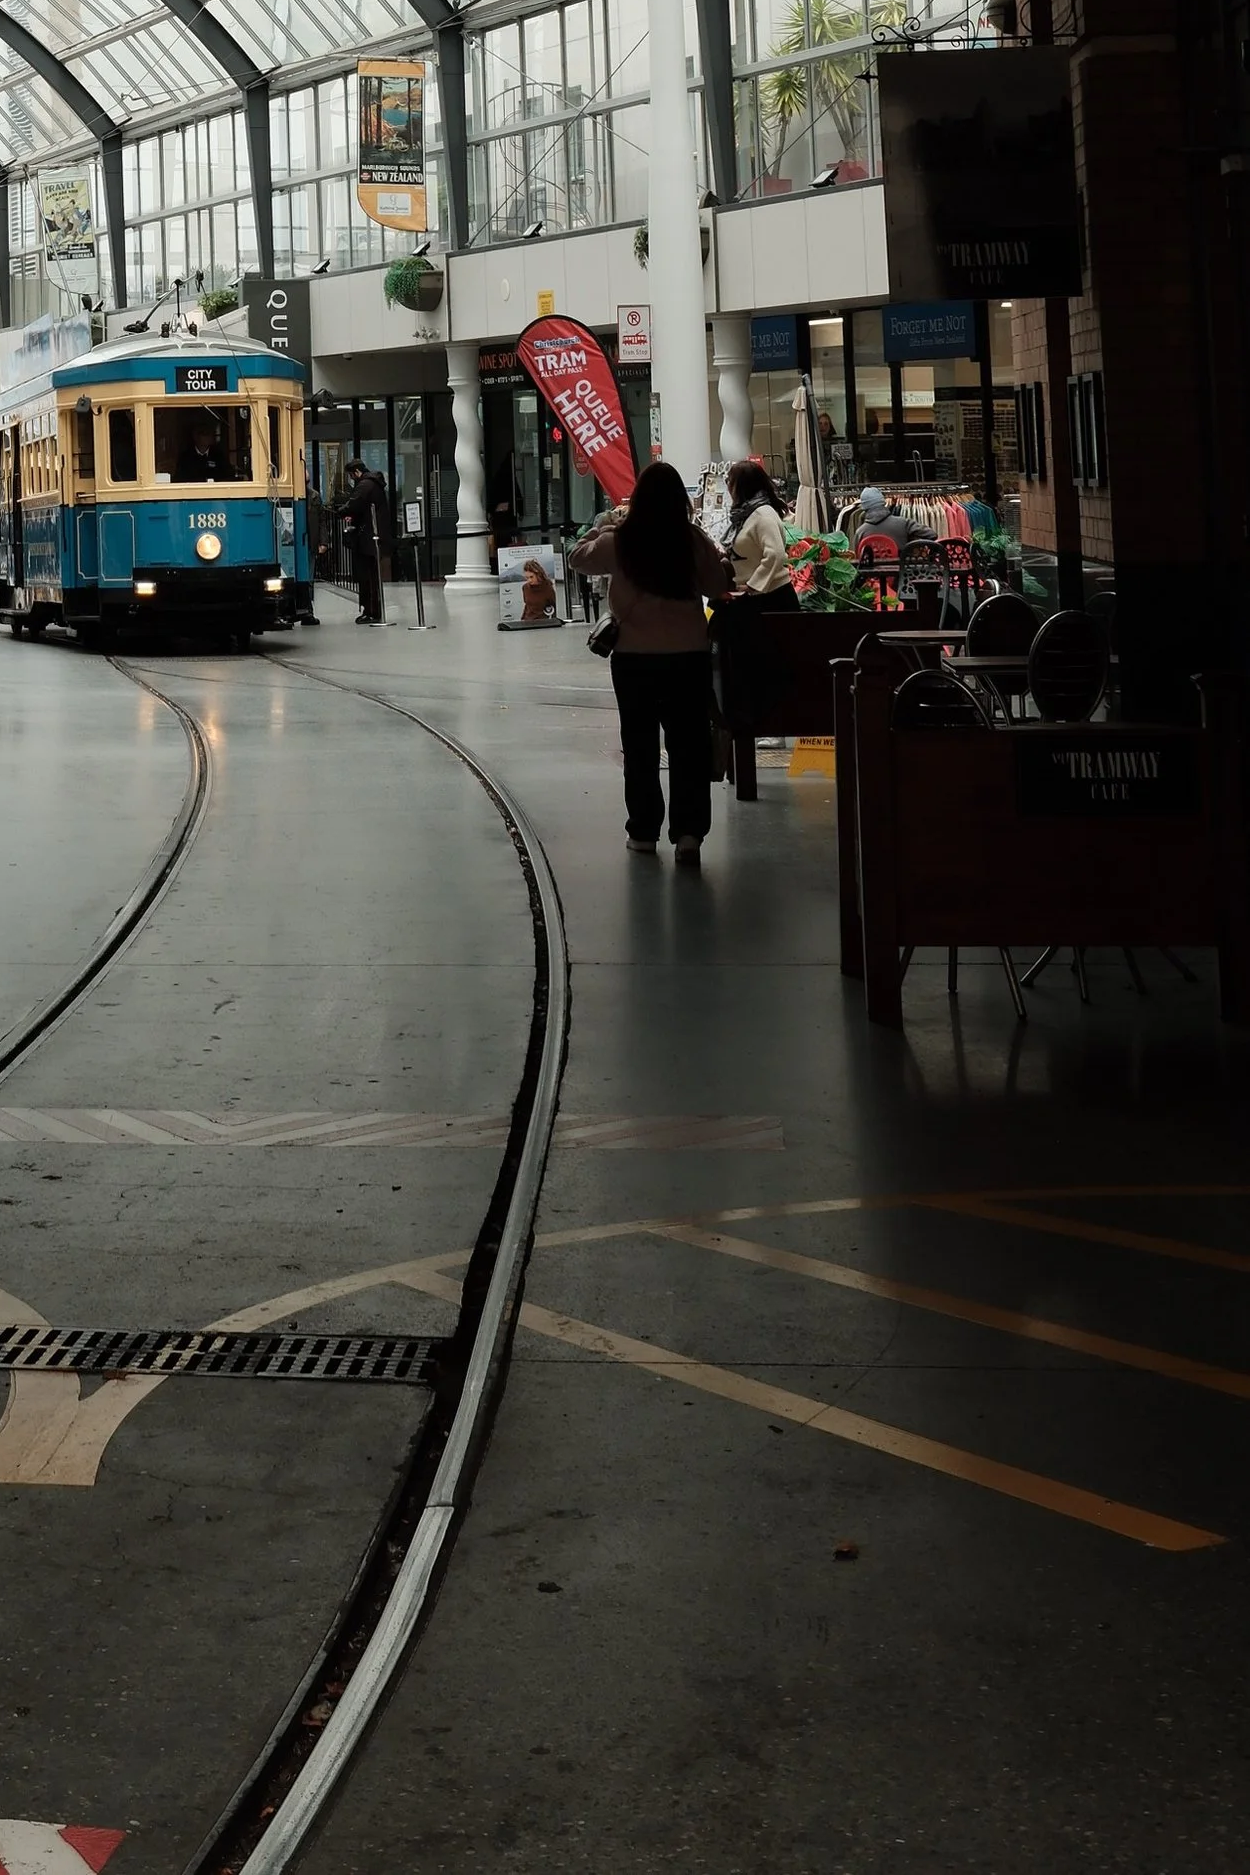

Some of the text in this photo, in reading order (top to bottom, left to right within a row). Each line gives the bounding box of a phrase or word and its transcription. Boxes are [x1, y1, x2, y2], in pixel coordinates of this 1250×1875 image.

[372, 172, 388, 182] NEW
[389, 171, 423, 183] ZEALAND
[43, 181, 76, 194] TRAVEL
[949, 240, 1031, 267] TRAMWAY
[890, 314, 967, 336] FORGET ME NOT
[772, 331, 790, 346] NOT
[635, 348, 648, 356] Stop
[498, 352, 518, 369] SPOT
[533, 349, 587, 372] TRAM
[187, 369, 213, 380] CITY
[541, 366, 583, 378] ALL DAY PASS
[184, 380, 216, 391] TOUR
[574, 378, 624, 443] QUEUE
[553, 388, 608, 458] HERE
[188, 513, 227, 529] 1888
[799, 737, 835, 746] WHEN WE
[1068, 751, 1162, 780] TRAMWAY
